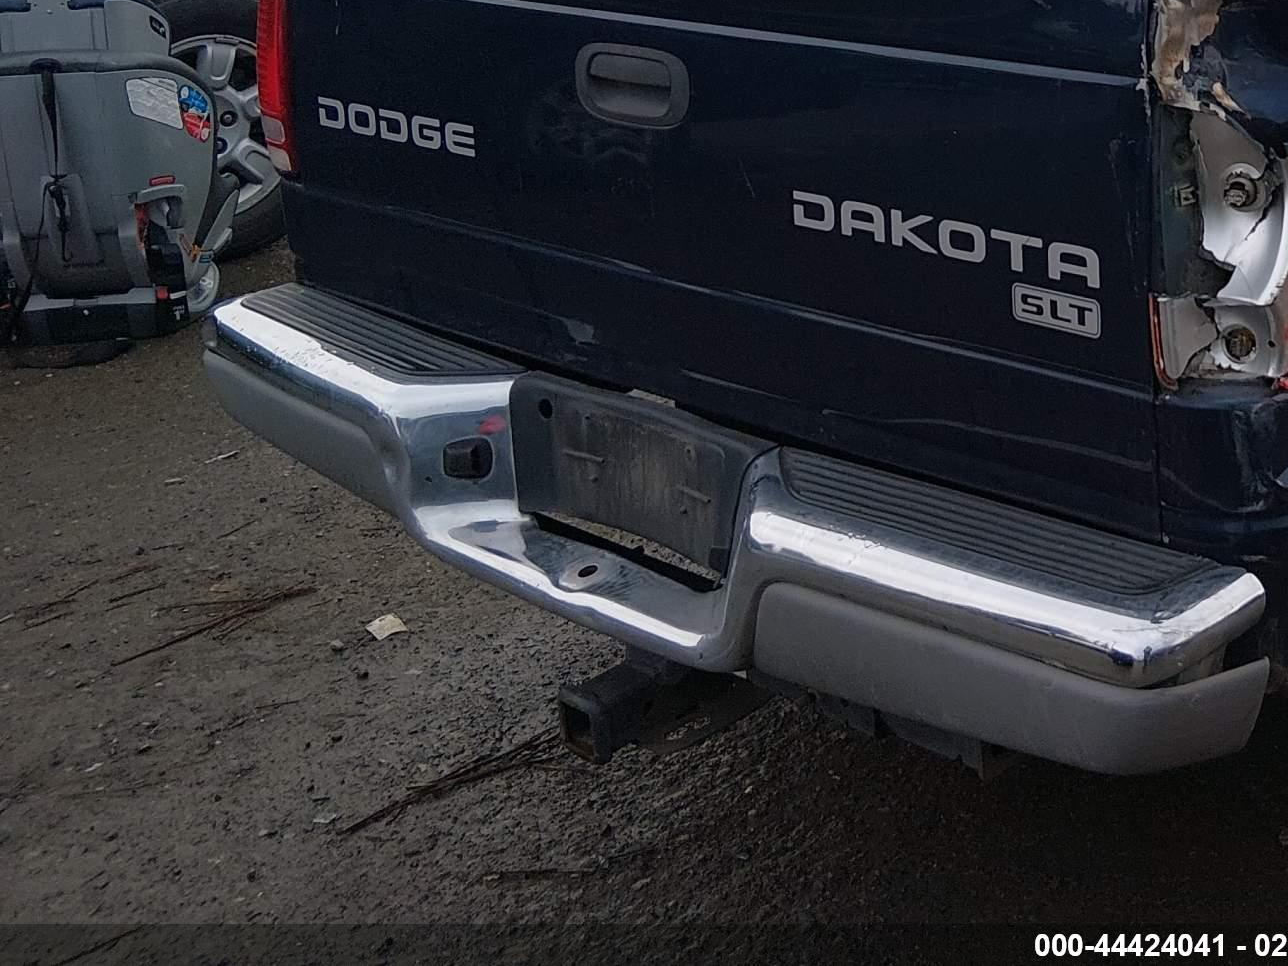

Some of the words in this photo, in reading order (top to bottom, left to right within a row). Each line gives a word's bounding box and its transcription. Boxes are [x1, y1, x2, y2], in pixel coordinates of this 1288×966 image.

[317, 95, 477, 158] DODGE
[792, 189, 1101, 290] DAKOTA
[1020, 292, 1094, 329] SLT
